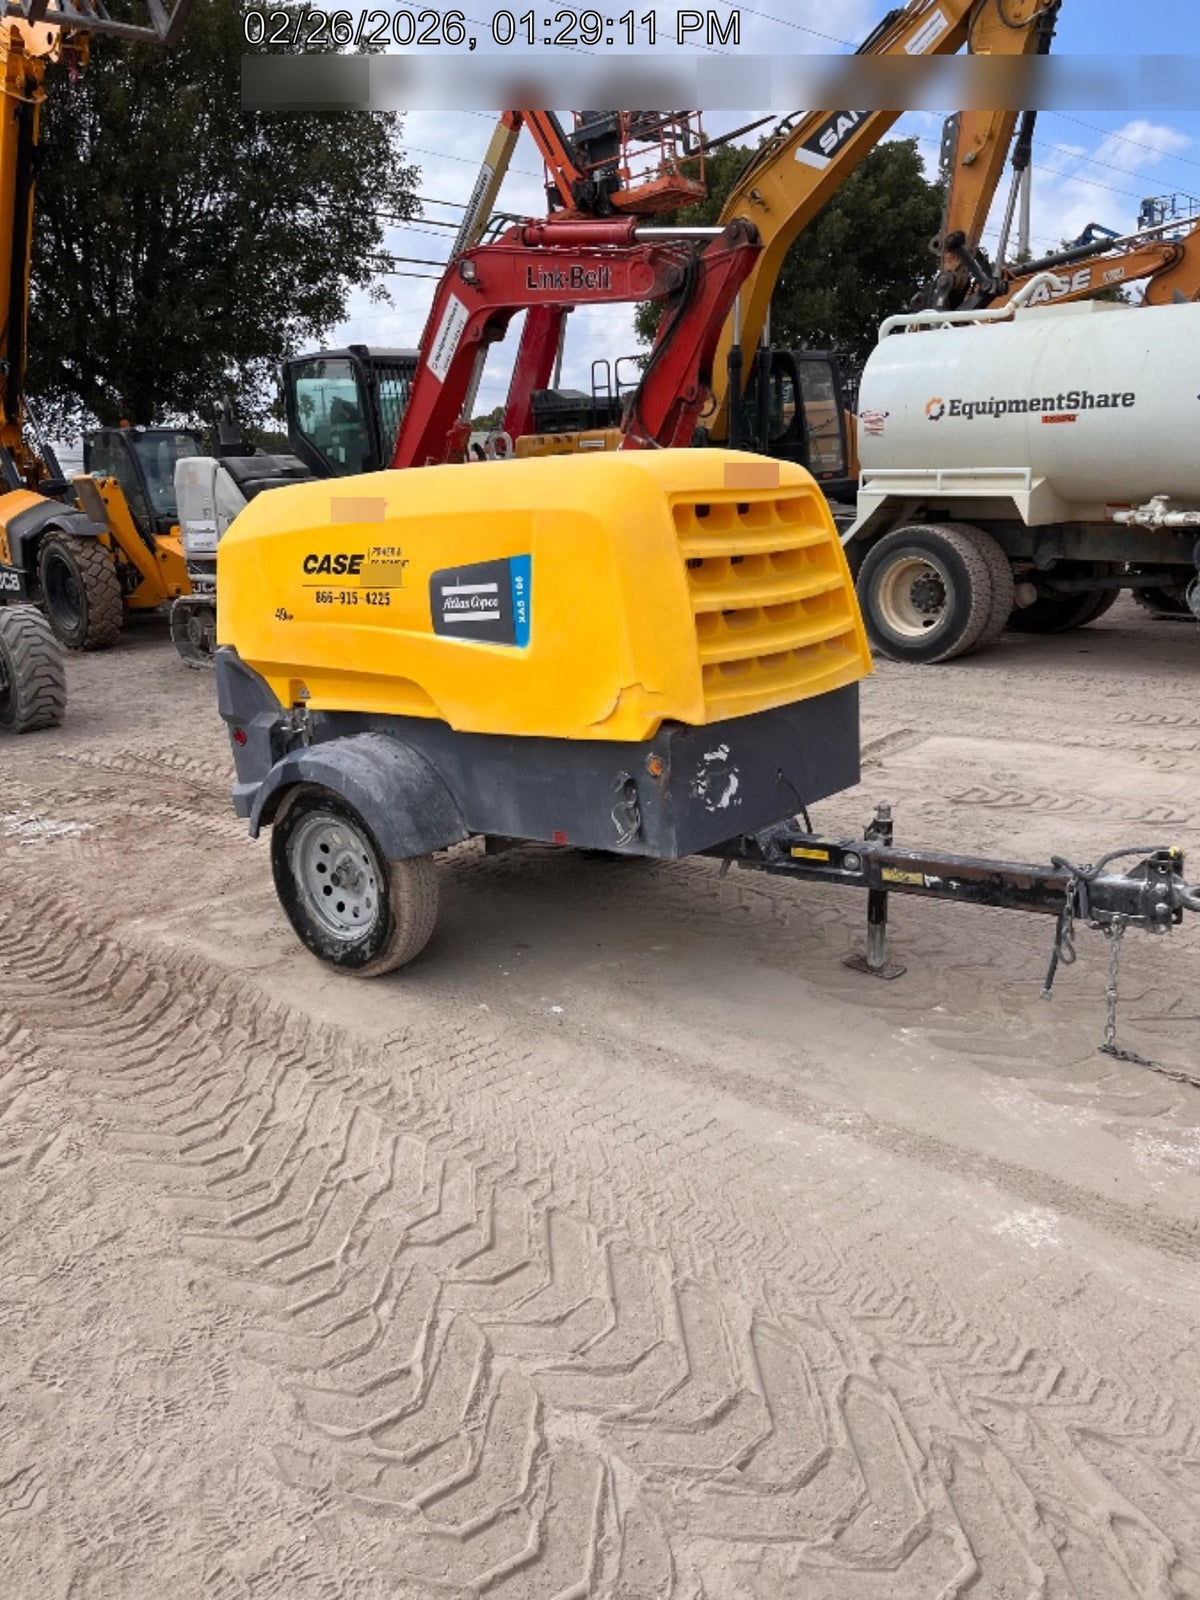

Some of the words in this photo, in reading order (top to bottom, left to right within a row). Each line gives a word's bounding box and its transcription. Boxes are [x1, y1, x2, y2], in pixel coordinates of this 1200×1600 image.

[1024, 267, 1092, 307] ASE
[947, 391, 1136, 421] EquipmentShare
[303, 553, 365, 576] CASE
